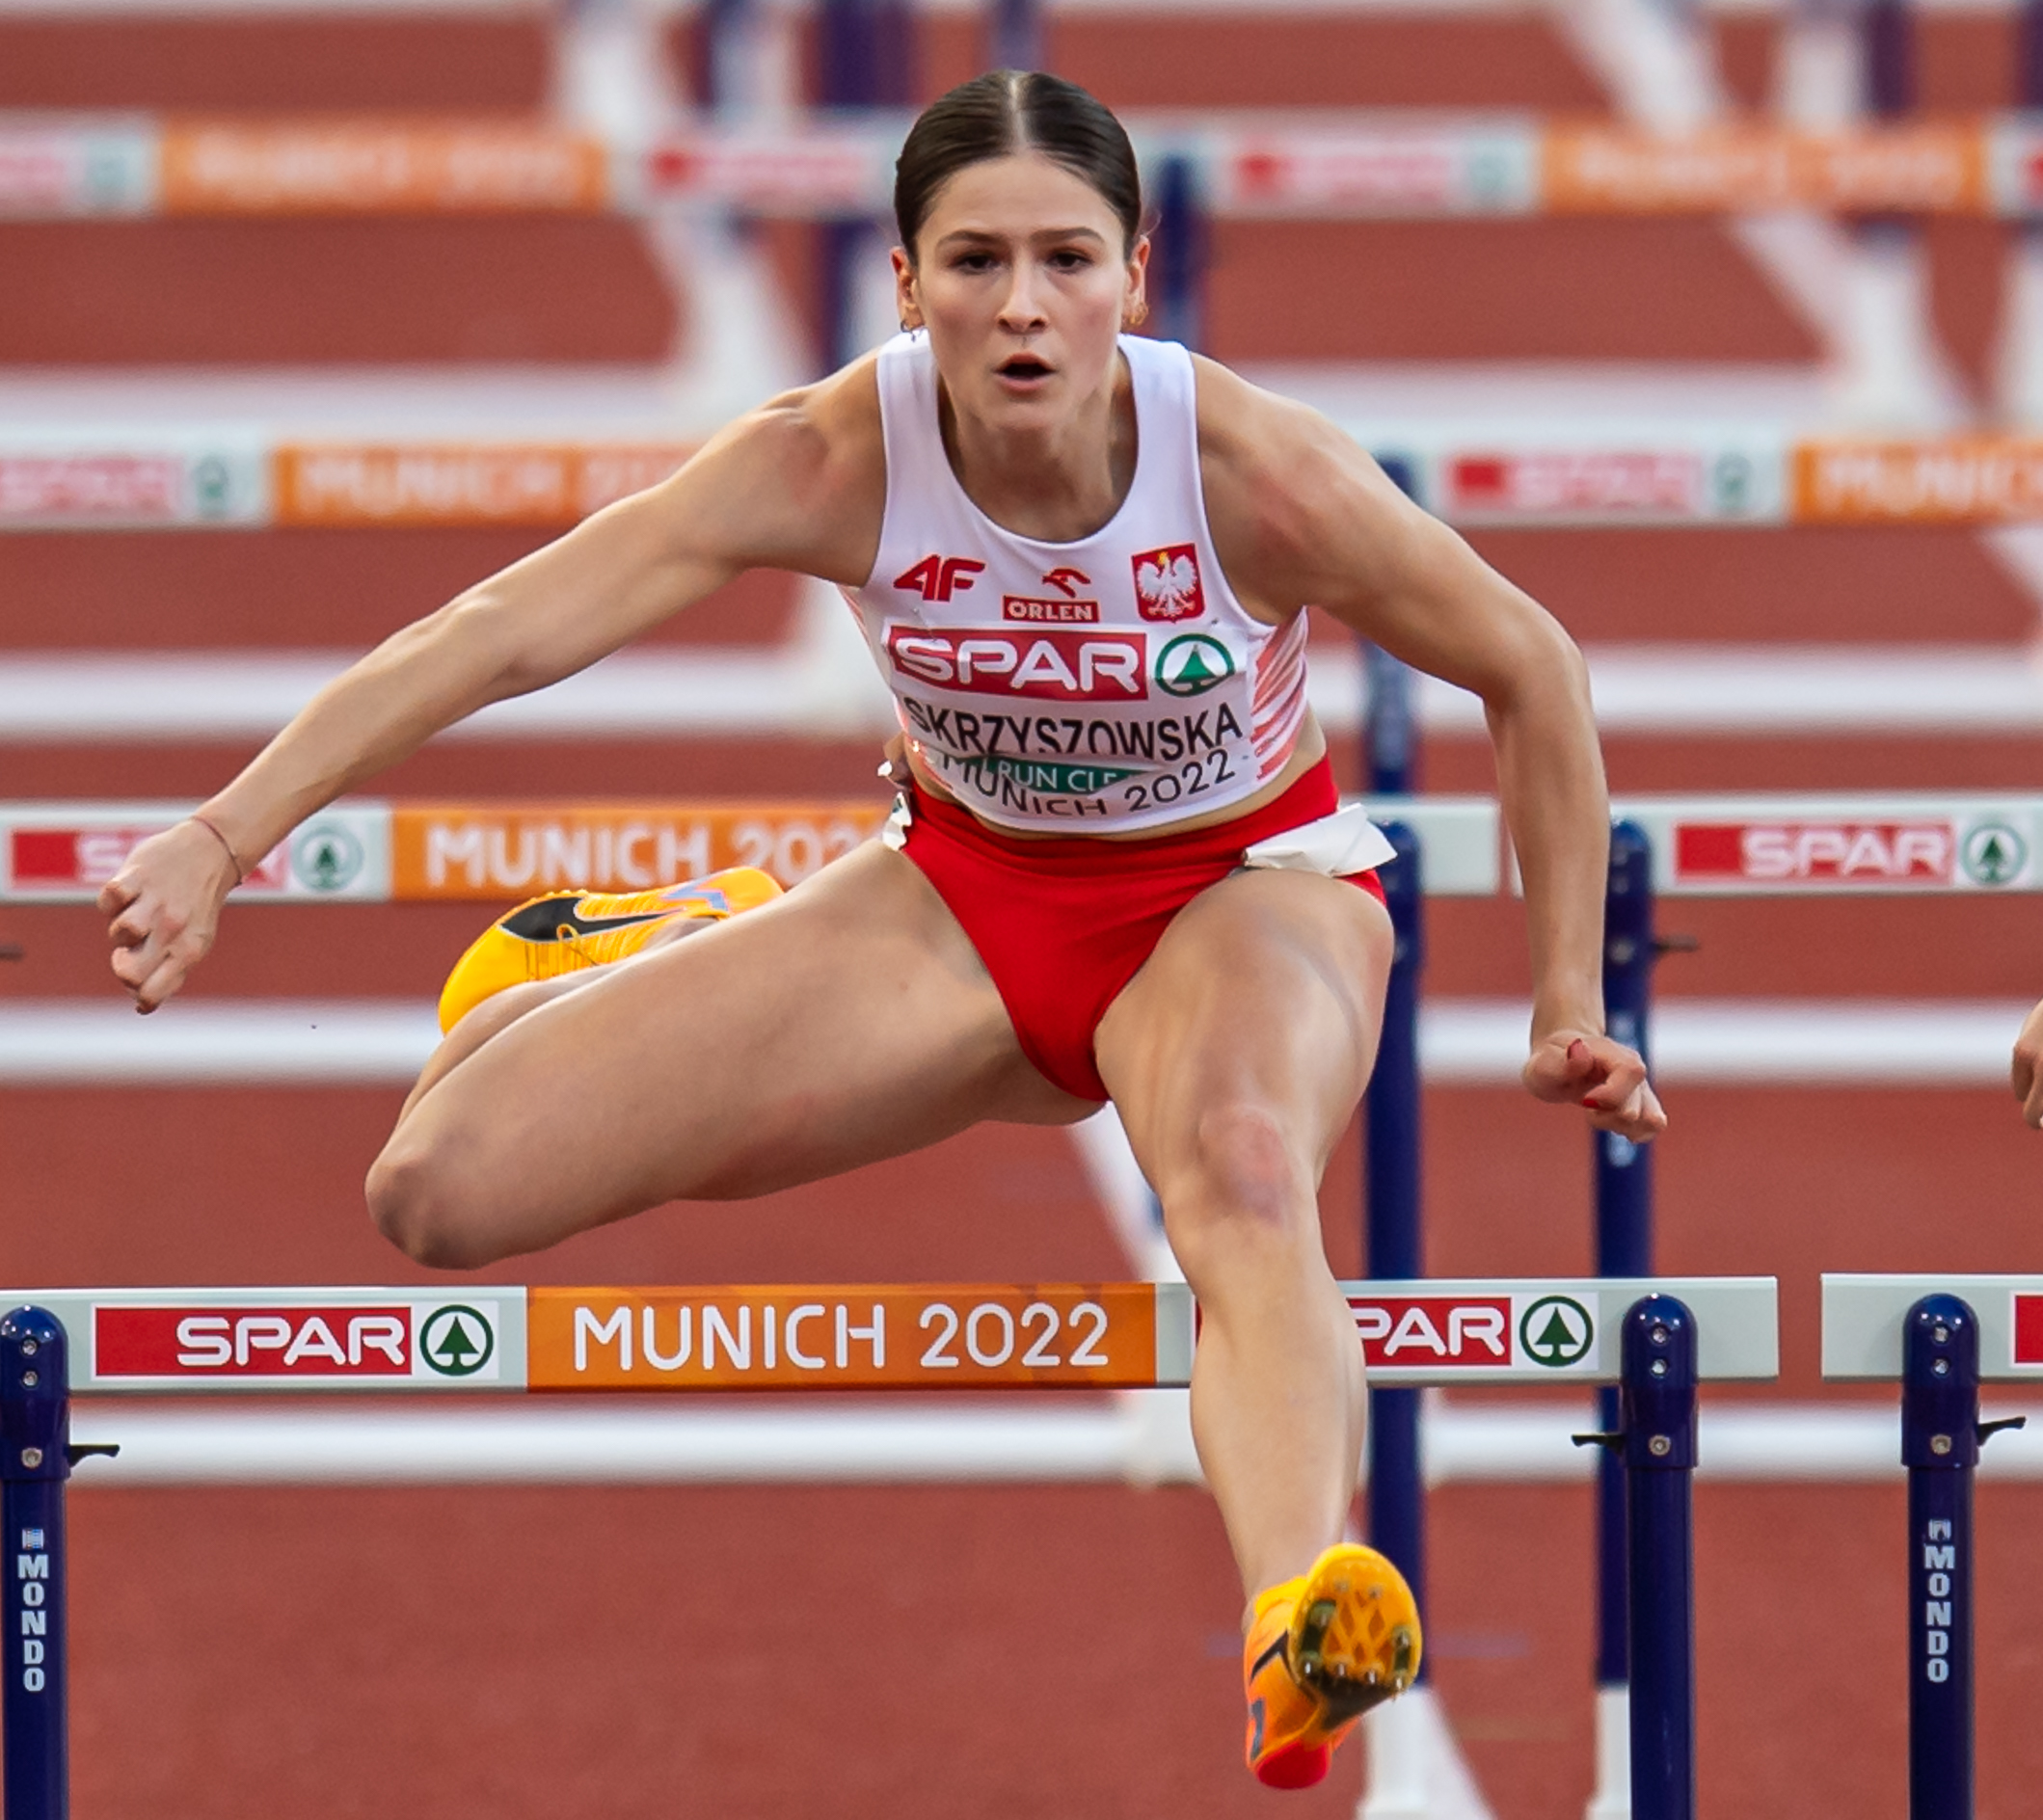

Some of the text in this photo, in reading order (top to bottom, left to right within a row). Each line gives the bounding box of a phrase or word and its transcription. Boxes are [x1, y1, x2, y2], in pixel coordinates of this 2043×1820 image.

[893, 554, 986, 602] 4F
[1007, 601, 1093, 621] ORLEN
[896, 636, 1140, 693] SPAR
[902, 696, 1243, 762] SKRZYSZOWSKA
[998, 760, 1058, 790] RUN
[1123, 748, 1235, 811] 2022
[425, 820, 711, 889] MUNICH
[1742, 829, 1949, 875] SPAR
[176, 1316, 406, 1366] SPAR
[574, 1301, 1109, 1371] MUNICH 2022
[1351, 1306, 1505, 1356] PAR
[17, 1554, 49, 1692] MONDO
[1924, 1545, 1956, 1683] MONDO
